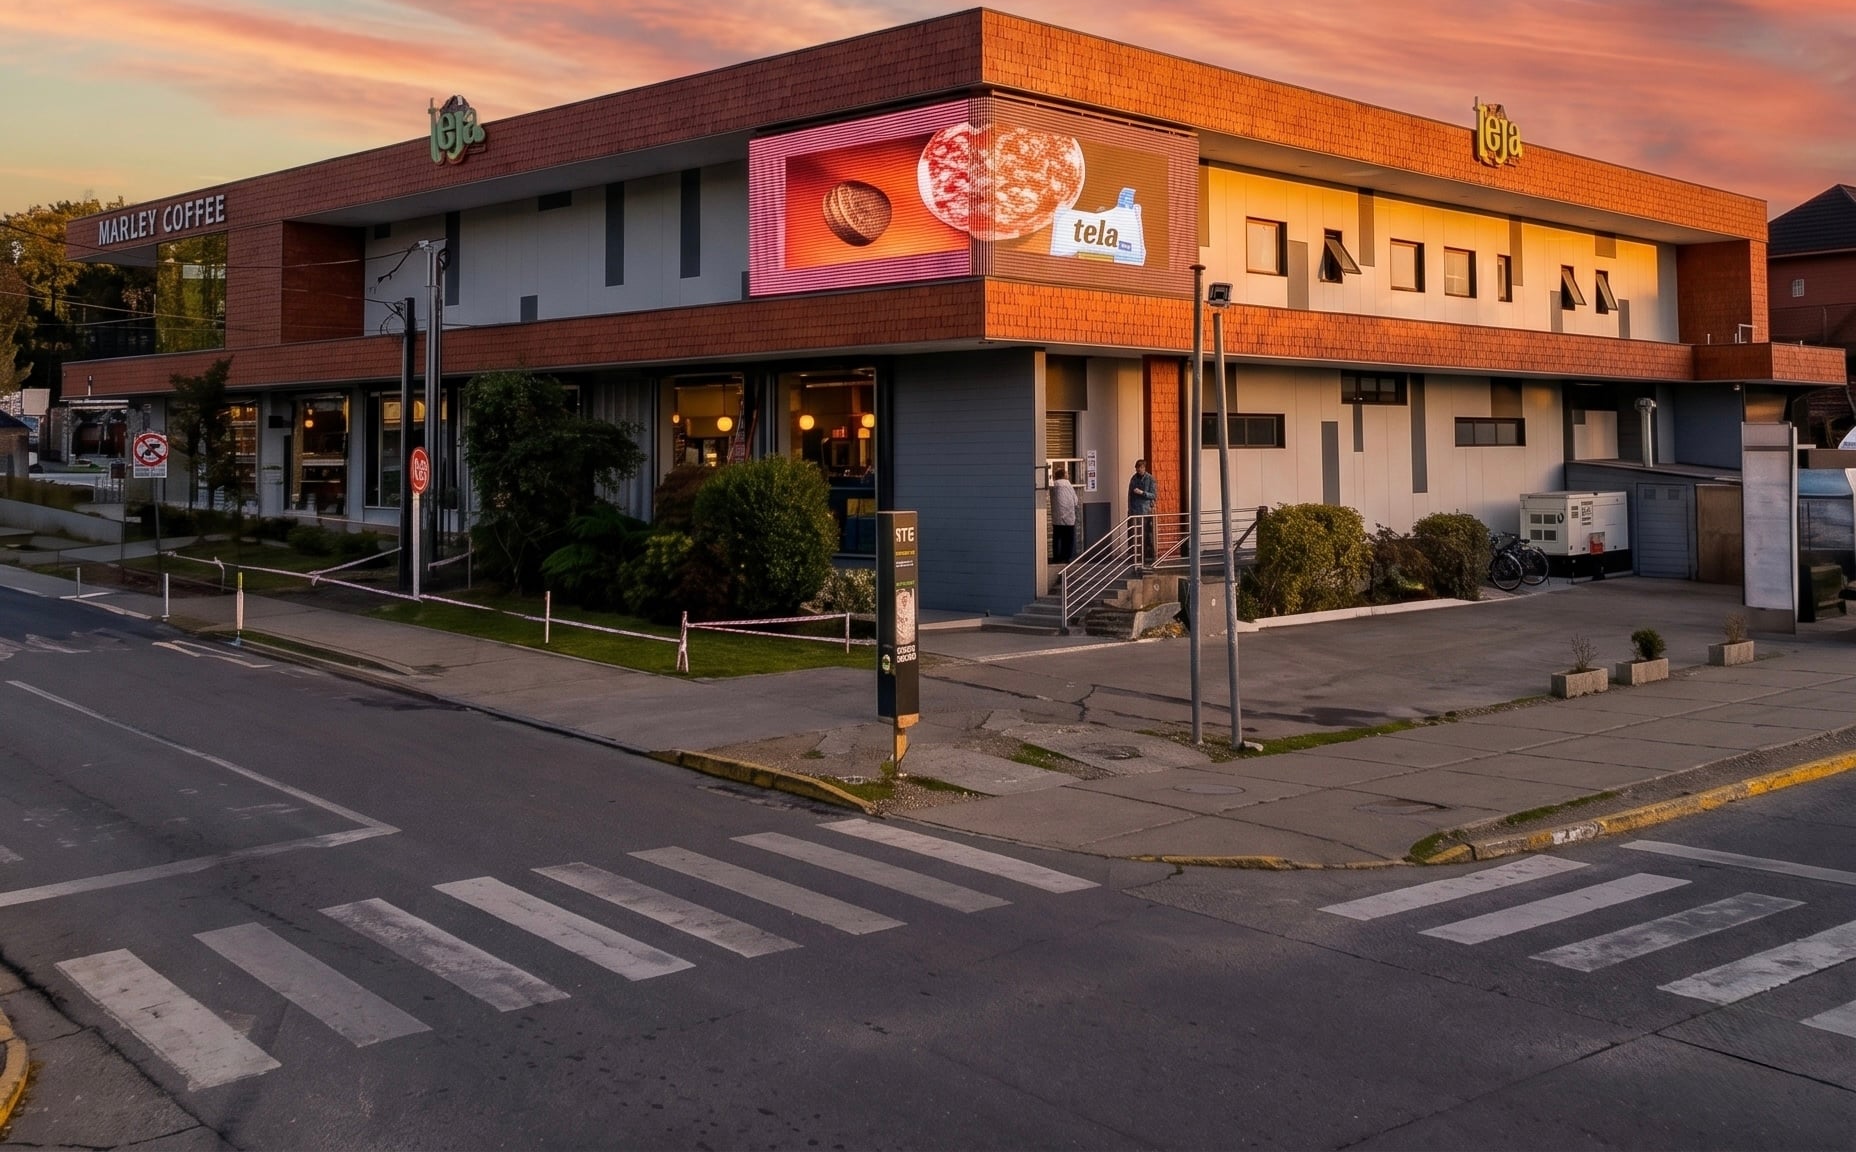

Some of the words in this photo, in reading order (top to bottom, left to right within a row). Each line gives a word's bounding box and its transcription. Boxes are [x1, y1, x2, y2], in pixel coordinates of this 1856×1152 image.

[98, 209, 157, 246] MARLEY
[163, 194, 225, 233] COFFEE
[1073, 218, 1119, 248] tela
